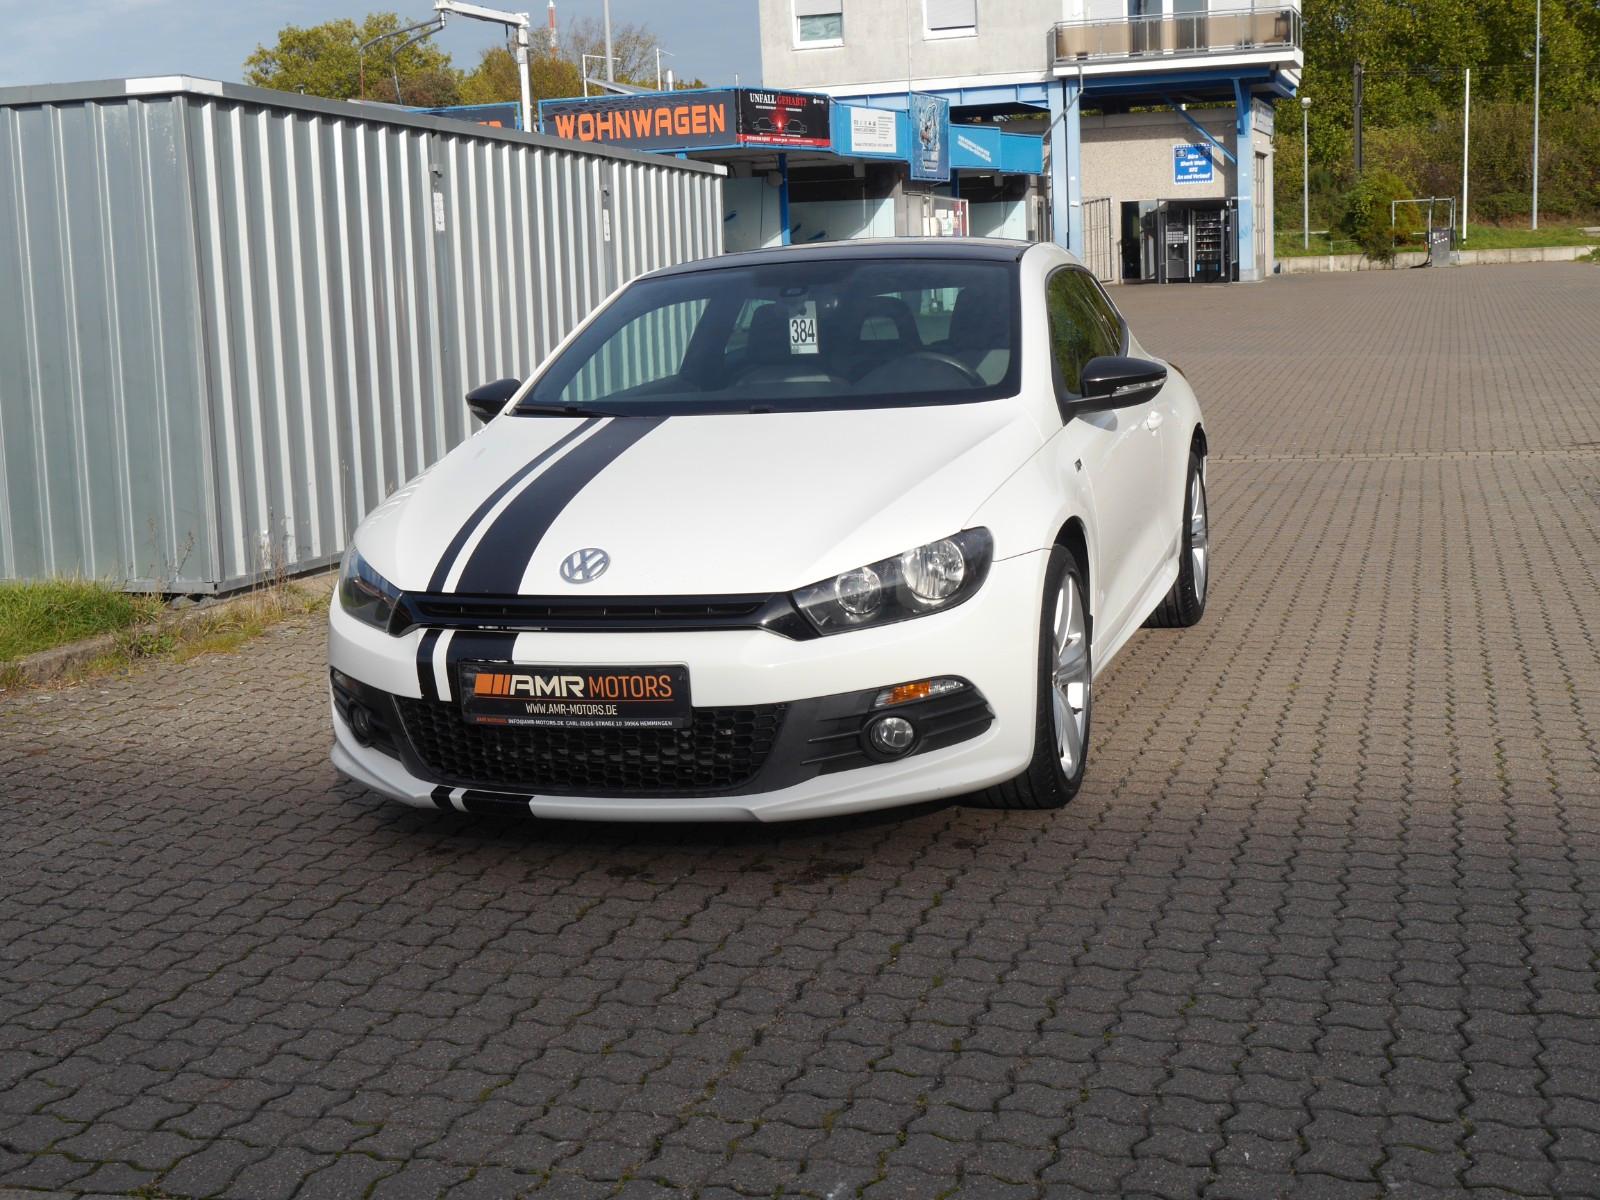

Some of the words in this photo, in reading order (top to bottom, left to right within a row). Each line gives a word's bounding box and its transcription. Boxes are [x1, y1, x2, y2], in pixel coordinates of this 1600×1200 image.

[749, 93, 777, 104] UNFALL
[777, 95, 807, 107] GEHABT?
[554, 103, 727, 142] WOHNWAGEN
[791, 319, 816, 344] 384
[560, 547, 611, 585] VW
[510, 674, 585, 697] AMR
[588, 675, 673, 698] MOTORS
[525, 703, 618, 716] WWW.AMR-MOTORS.DE
